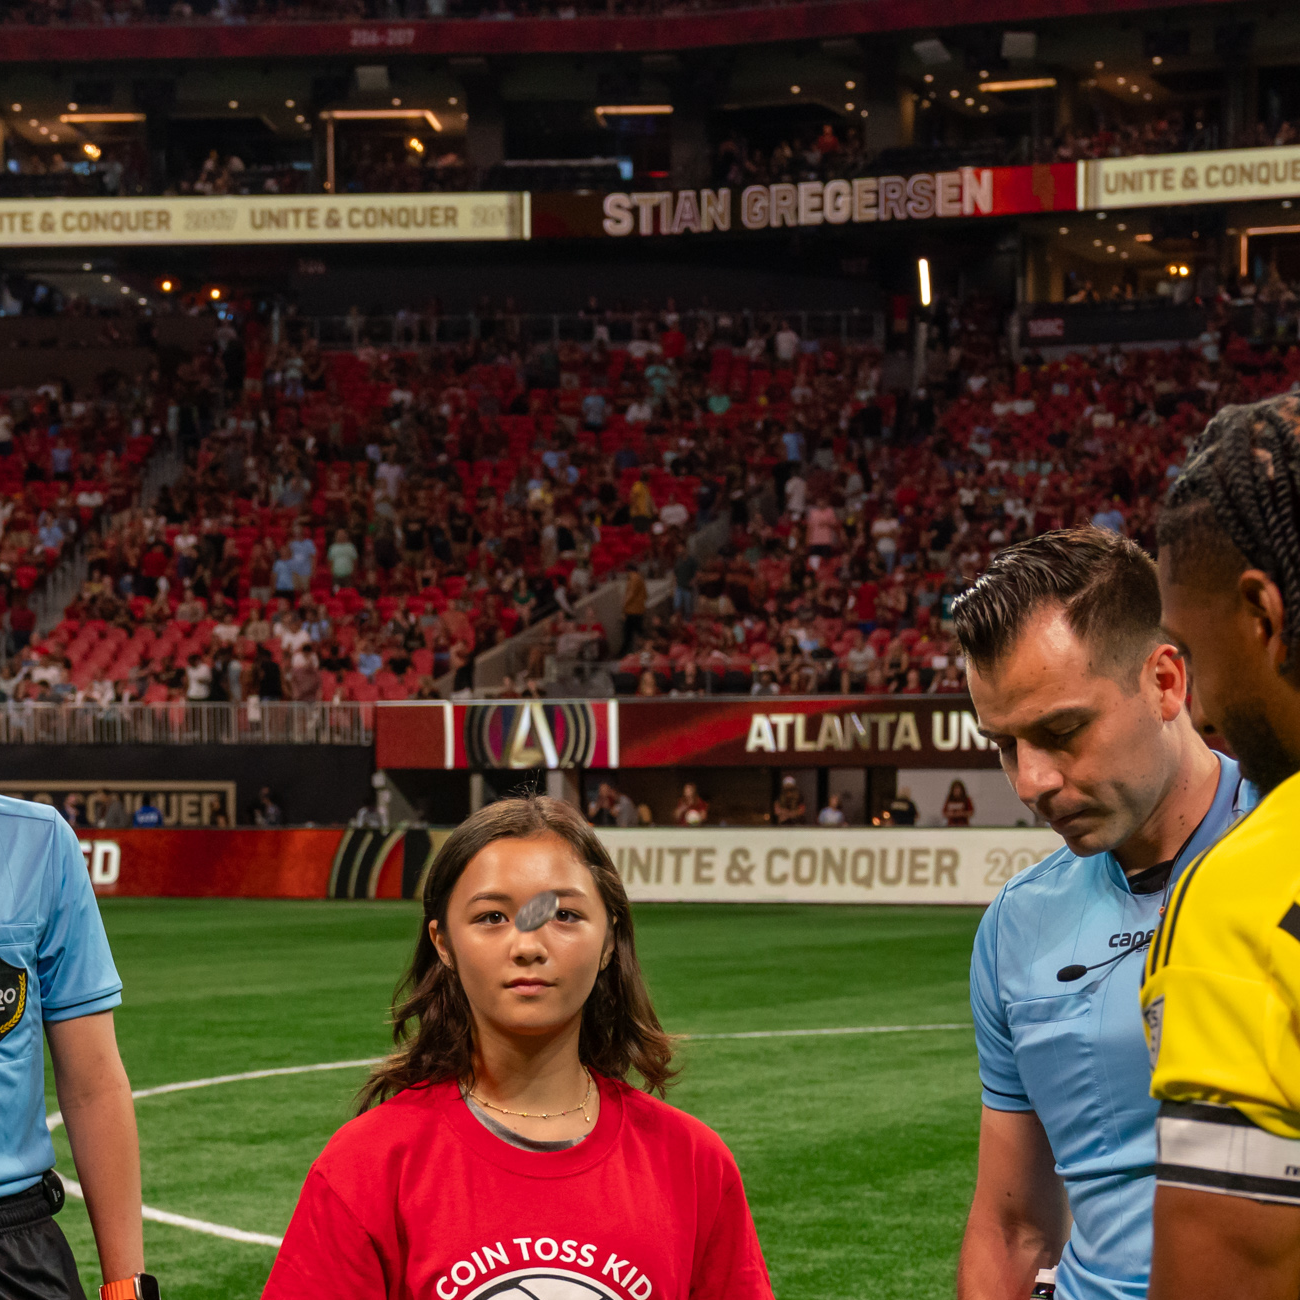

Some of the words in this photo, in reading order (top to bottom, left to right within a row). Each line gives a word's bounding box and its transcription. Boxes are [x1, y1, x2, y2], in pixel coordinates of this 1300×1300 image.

[1104, 168, 1175, 194] UNITE
[1182, 166, 1198, 191] &
[40, 211, 55, 233] &
[61, 210, 172, 233] CONQUER
[250, 206, 318, 230] UNITE
[324, 206, 342, 229] &
[350, 206, 459, 230] CONQUER
[602, 187, 731, 237] STIAN
[740, 168, 993, 230] GREGERSEN
[747, 713, 921, 753] ATLANTA
[724, 847, 757, 886] &
[765, 847, 960, 887] CONQUER
[436, 1241, 510, 1300] COIN
[512, 1237, 598, 1268] TOSS
